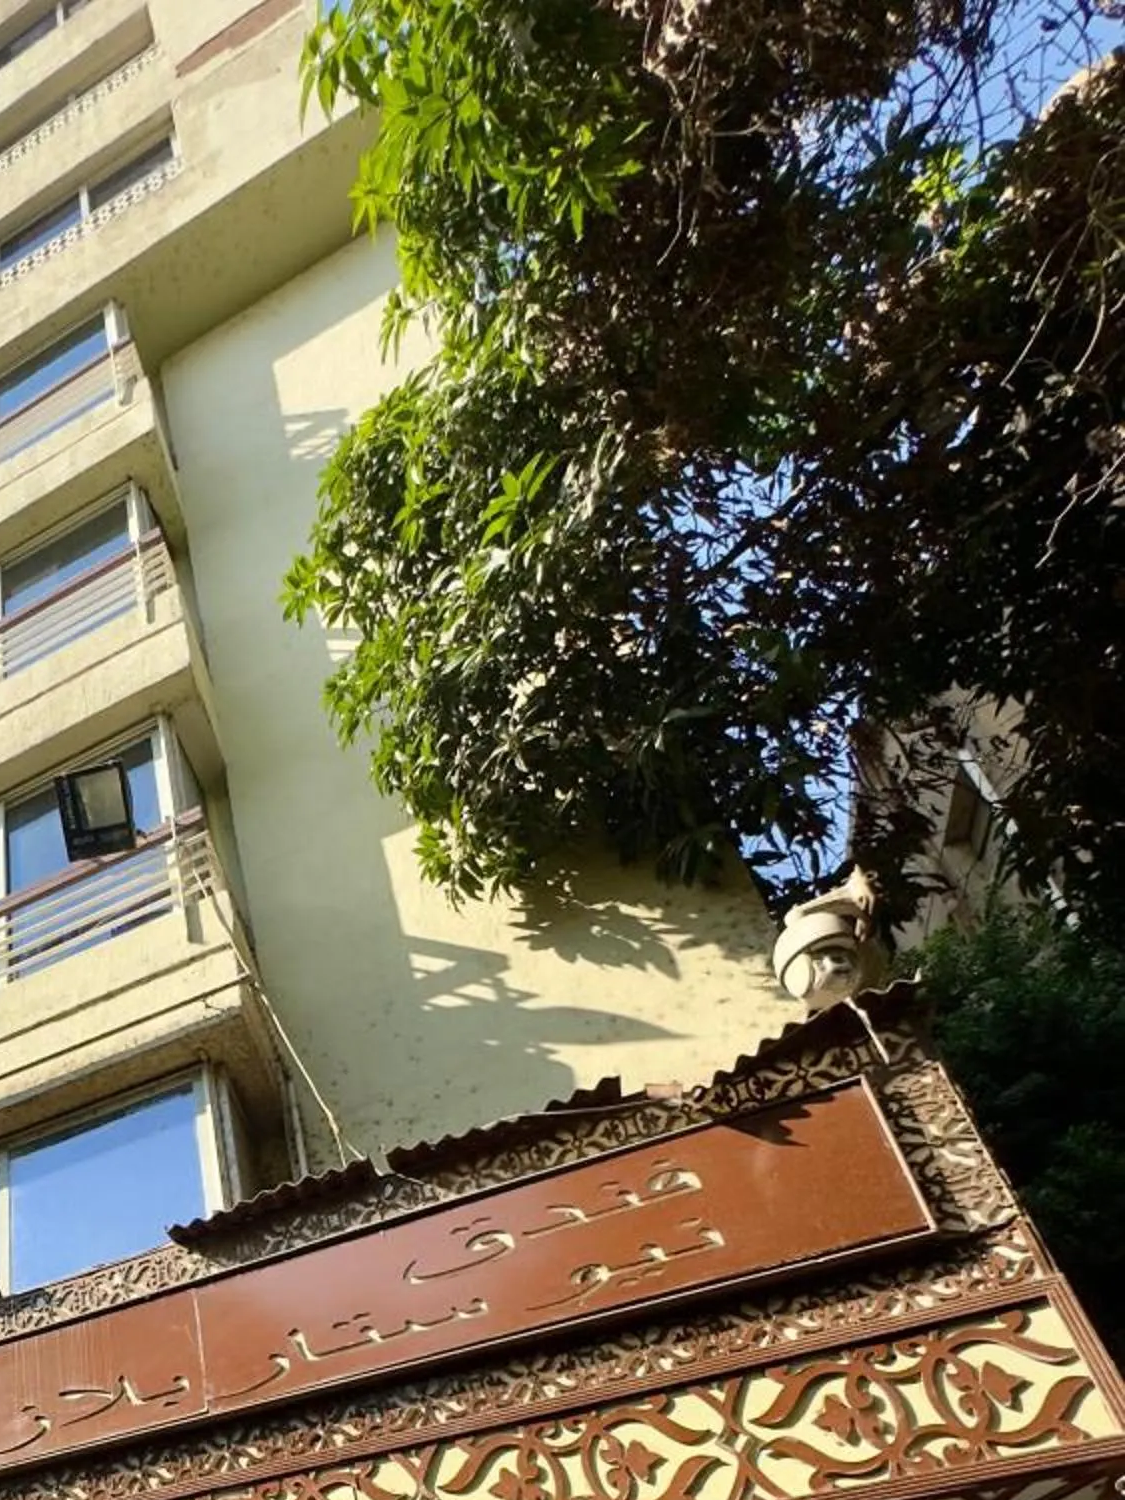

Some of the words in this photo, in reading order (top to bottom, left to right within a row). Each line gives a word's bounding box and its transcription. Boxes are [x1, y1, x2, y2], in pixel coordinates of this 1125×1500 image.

[402, 1160, 703, 1284] فندق
[526, 1217, 725, 1312] نيو
[207, 1298, 488, 1400] ستار
